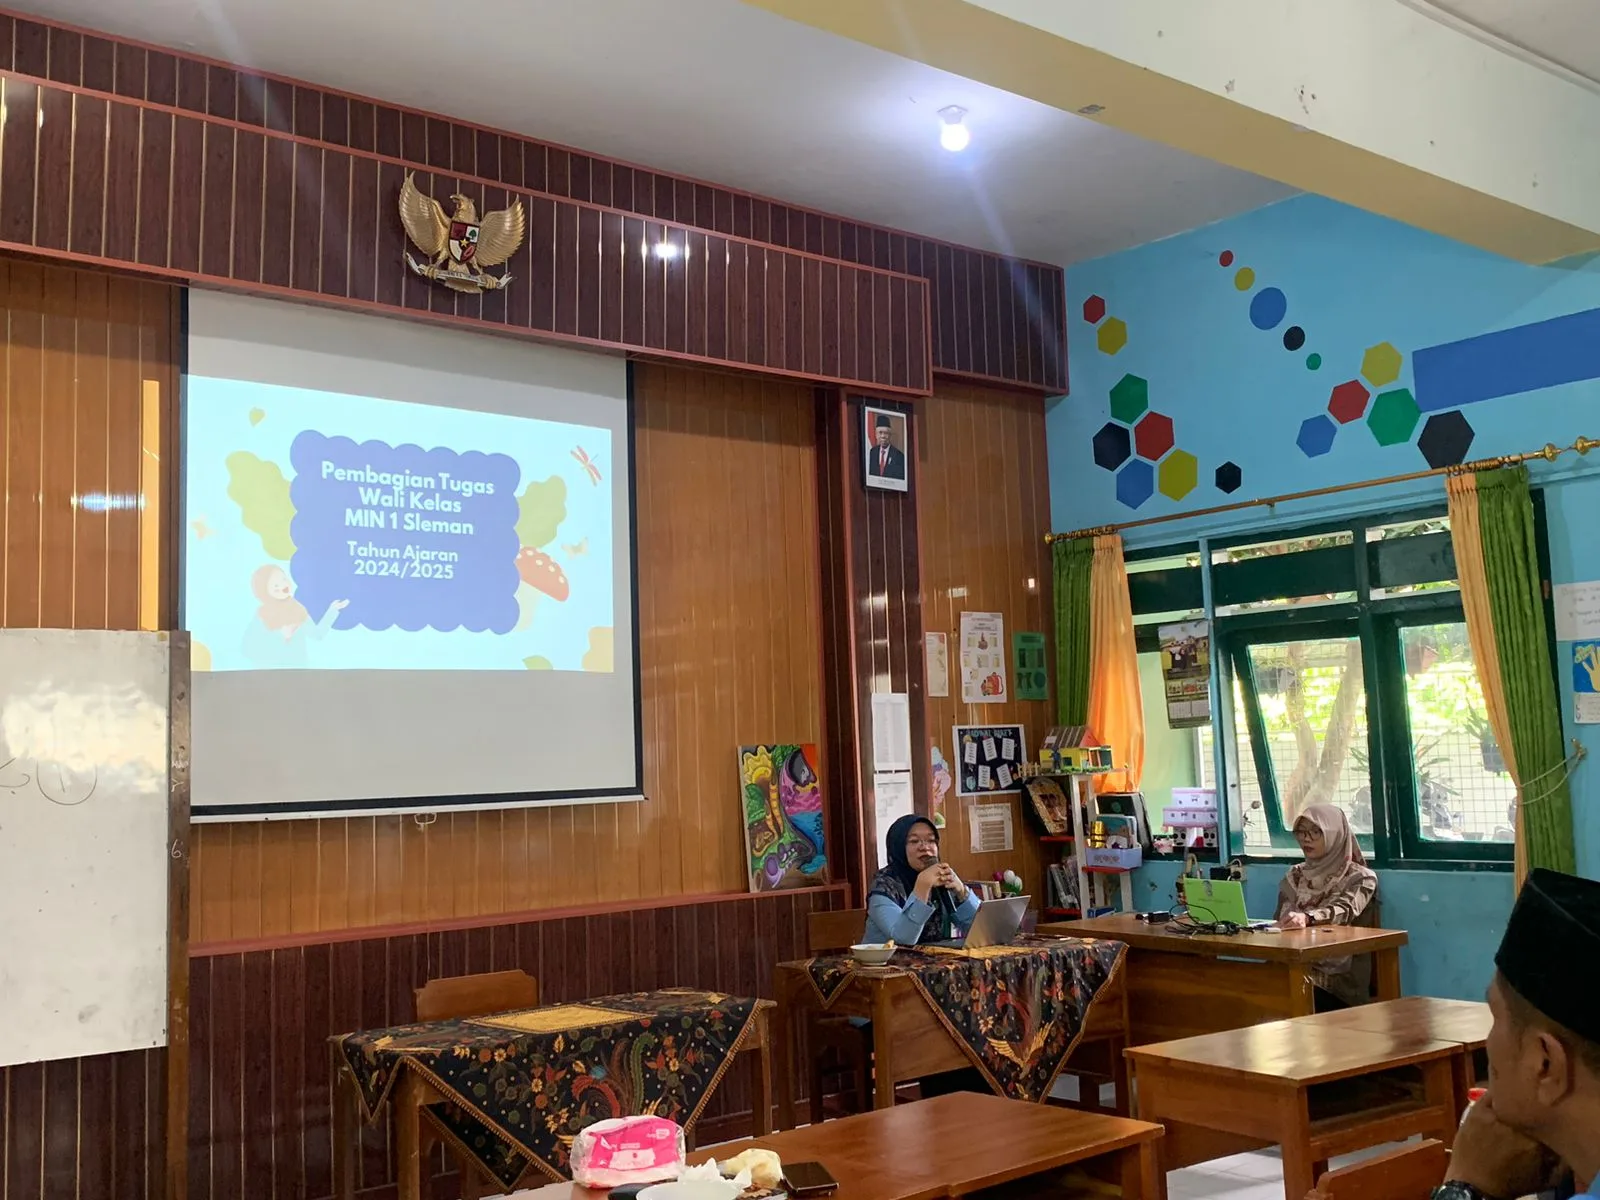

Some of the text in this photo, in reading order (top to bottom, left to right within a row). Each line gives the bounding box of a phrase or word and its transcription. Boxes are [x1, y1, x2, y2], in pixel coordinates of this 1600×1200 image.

[321, 460, 495, 498] Pembagian Tugas
[358, 486, 462, 513] Wali Kelas
[344, 507, 474, 535] MIN 1 Sleman
[346, 540, 459, 567] Tahun Ajaran
[353, 559, 454, 579] 2024/2025
